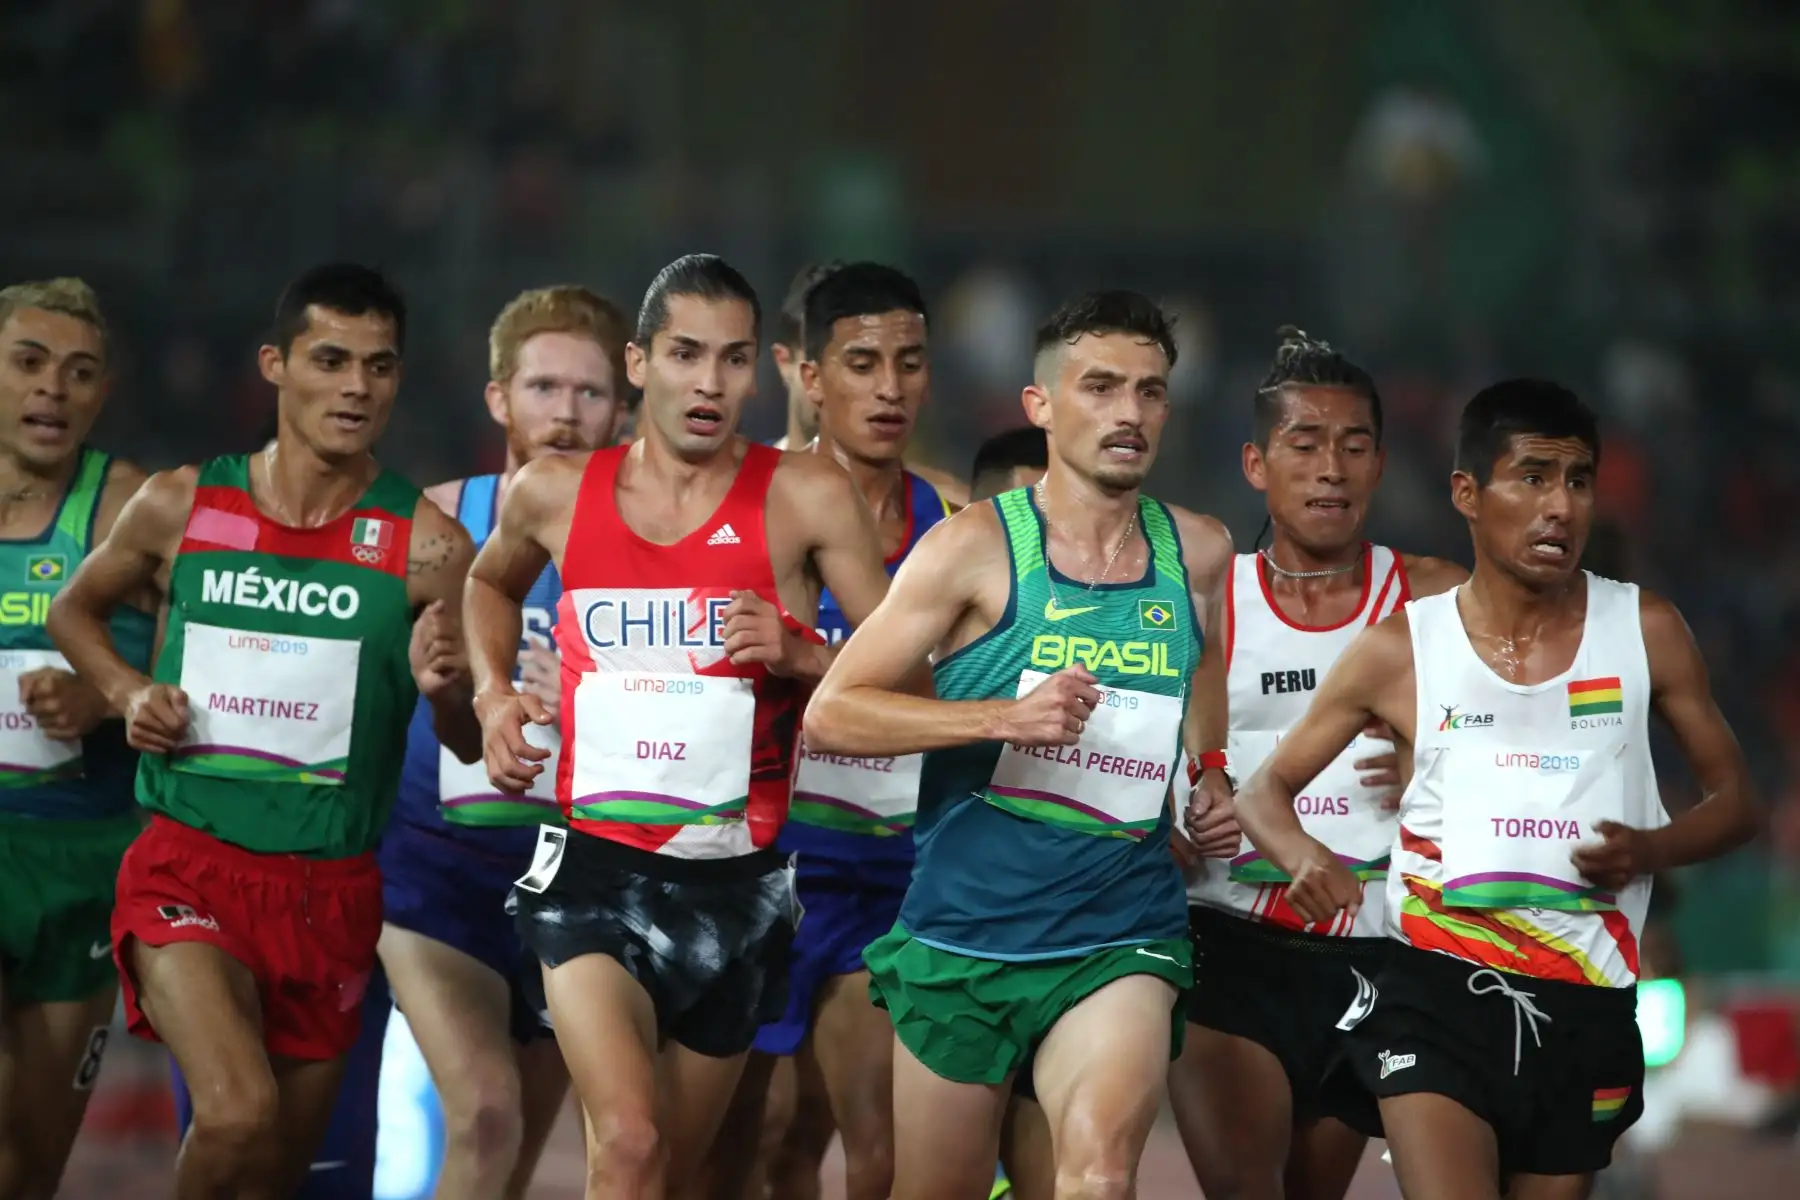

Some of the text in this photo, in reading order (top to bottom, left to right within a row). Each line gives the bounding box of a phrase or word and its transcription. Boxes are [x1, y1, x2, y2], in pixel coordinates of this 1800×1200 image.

[202, 566, 359, 619] MÉXICO
[585, 600, 733, 647] CHILE
[228, 635, 308, 655] Lima2019
[1031, 634, 1179, 677] BRASIL
[624, 678, 704, 694] Lima2019
[1261, 668, 1316, 695] PERU
[208, 692, 319, 721] MARTINEZ
[1464, 714, 1494, 725] FAB
[1571, 717, 1623, 730] BOLIVIA
[636, 741, 686, 760] DIAZ
[1086, 752, 1166, 782] PEREIRA
[1495, 753, 1580, 770] Lima2019
[1297, 796, 1349, 815] OJAS
[1491, 818, 1581, 840] TOROYA
